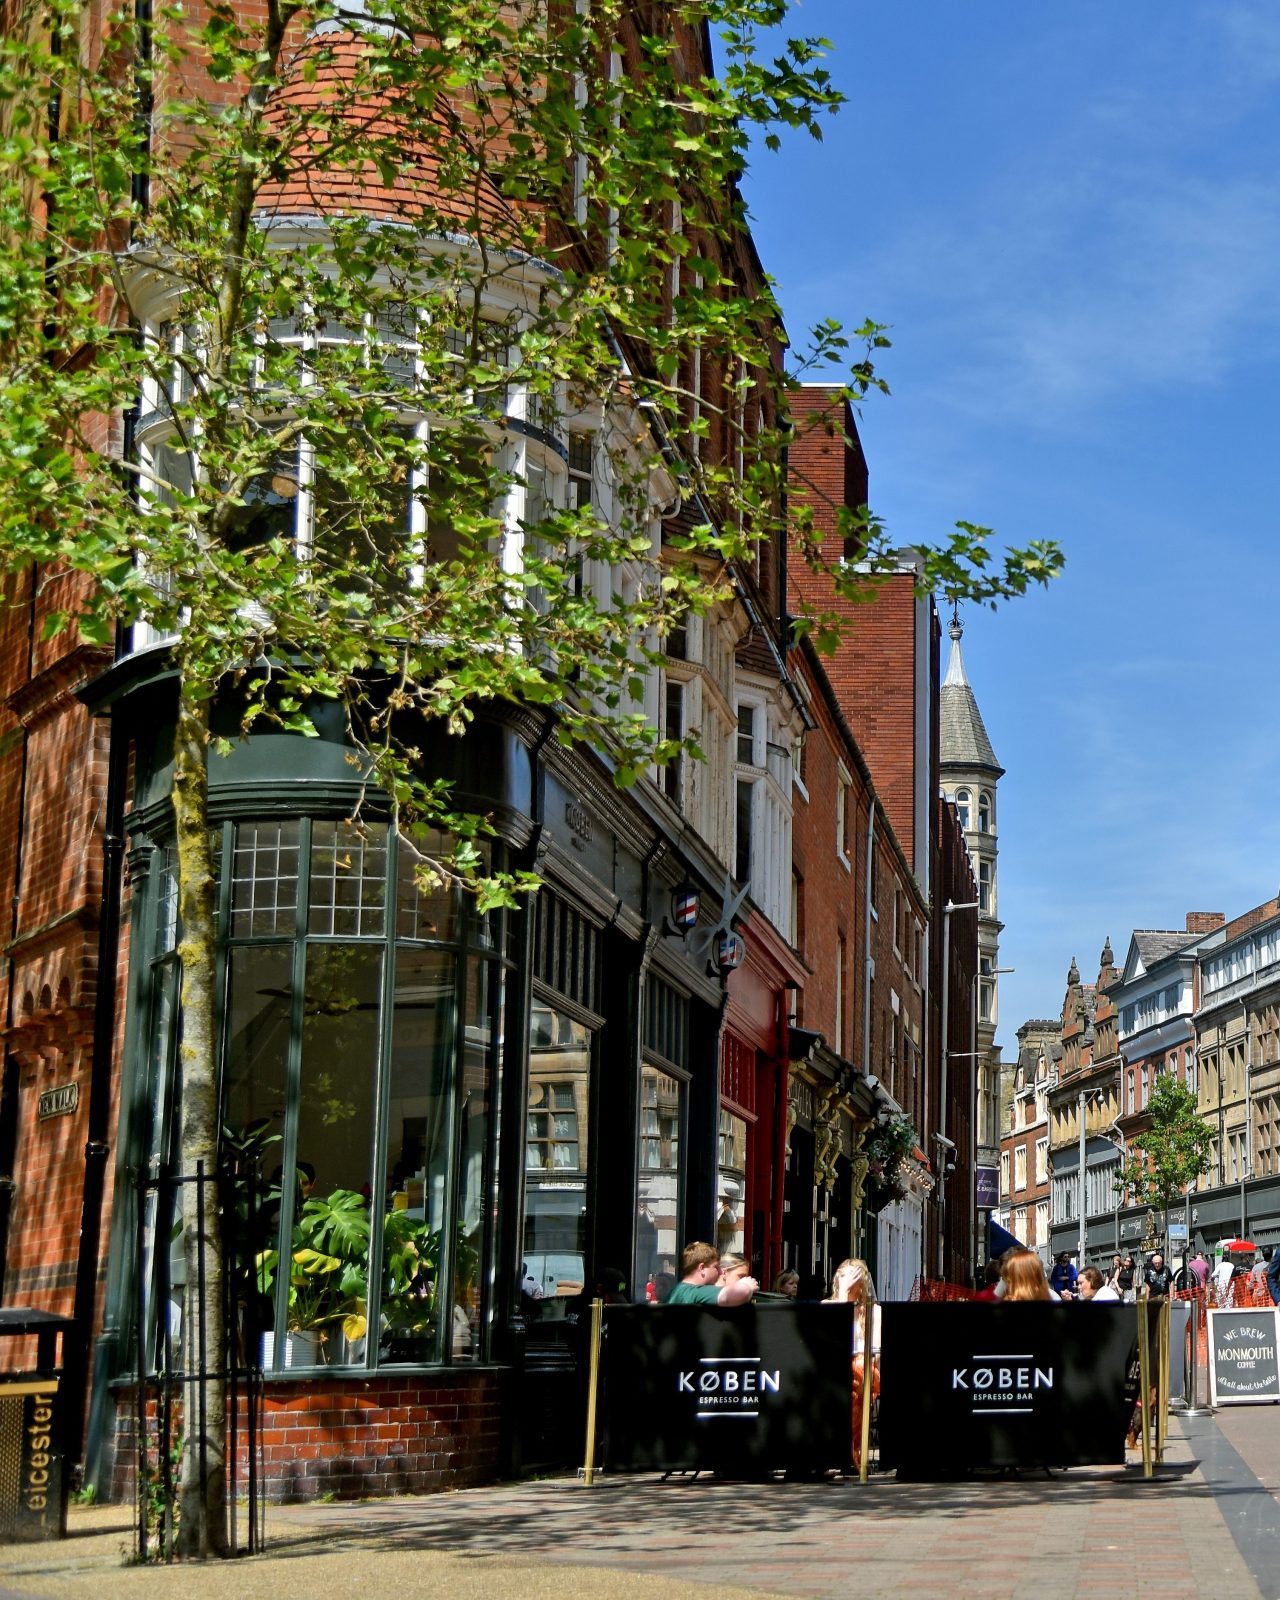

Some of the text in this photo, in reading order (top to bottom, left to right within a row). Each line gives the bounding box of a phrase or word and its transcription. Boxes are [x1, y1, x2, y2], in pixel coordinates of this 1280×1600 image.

[1223, 1327, 1266, 1340] WE BREW
[1217, 1346, 1274, 1361] MONMOUTH
[1237, 1361, 1256, 1369] COFFEE
[679, 1370, 780, 1392] KØBEN
[953, 1367, 1053, 1389] KØBEN
[699, 1396, 739, 1404] ESPRESSO
